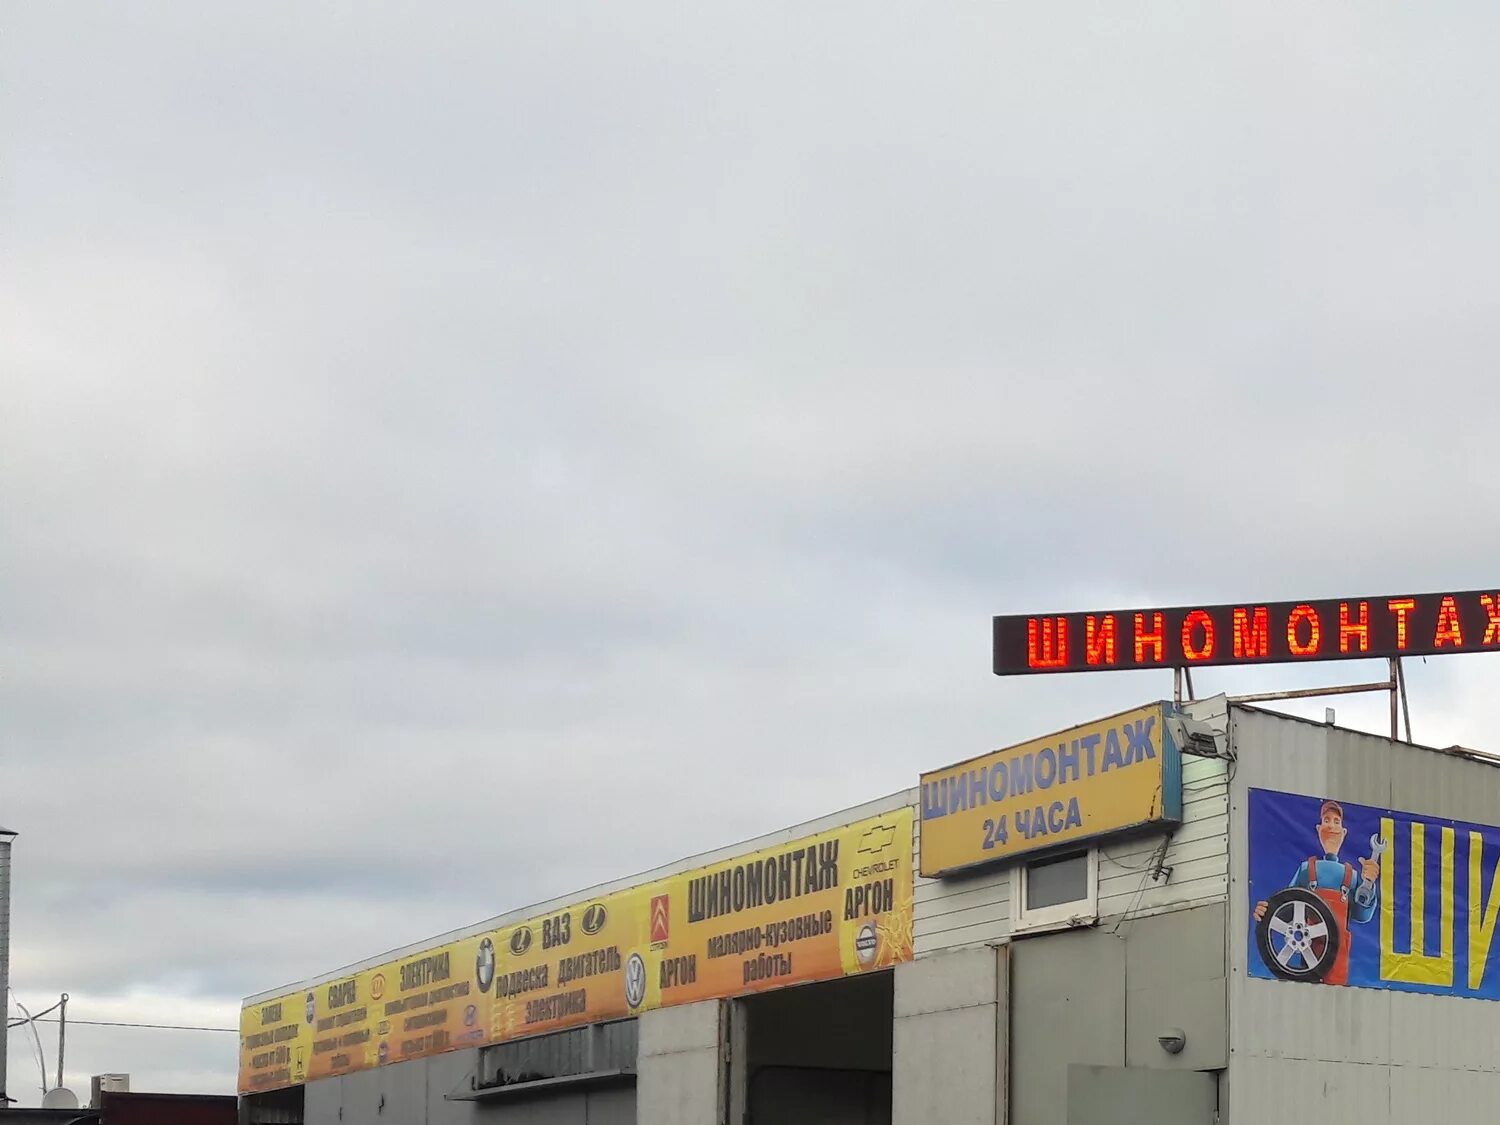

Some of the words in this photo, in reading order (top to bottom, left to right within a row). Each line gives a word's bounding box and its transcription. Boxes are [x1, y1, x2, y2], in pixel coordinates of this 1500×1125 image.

[923, 715, 1156, 821] ШИНОМОНТАЖ
[982, 814, 1009, 850] 24
[1015, 796, 1082, 840] ЧАСА
[687, 838, 840, 923] ШИНОМОНТАЖ
[852, 858, 900, 880] CHEVROLET
[843, 878, 894, 921] АРГОН
[541, 912, 572, 950] ВАЗ
[707, 909, 832, 960] малярно-кузовные
[557, 945, 621, 989] двигатель
[659, 954, 697, 990] АРГОН
[743, 951, 792, 986] работы
